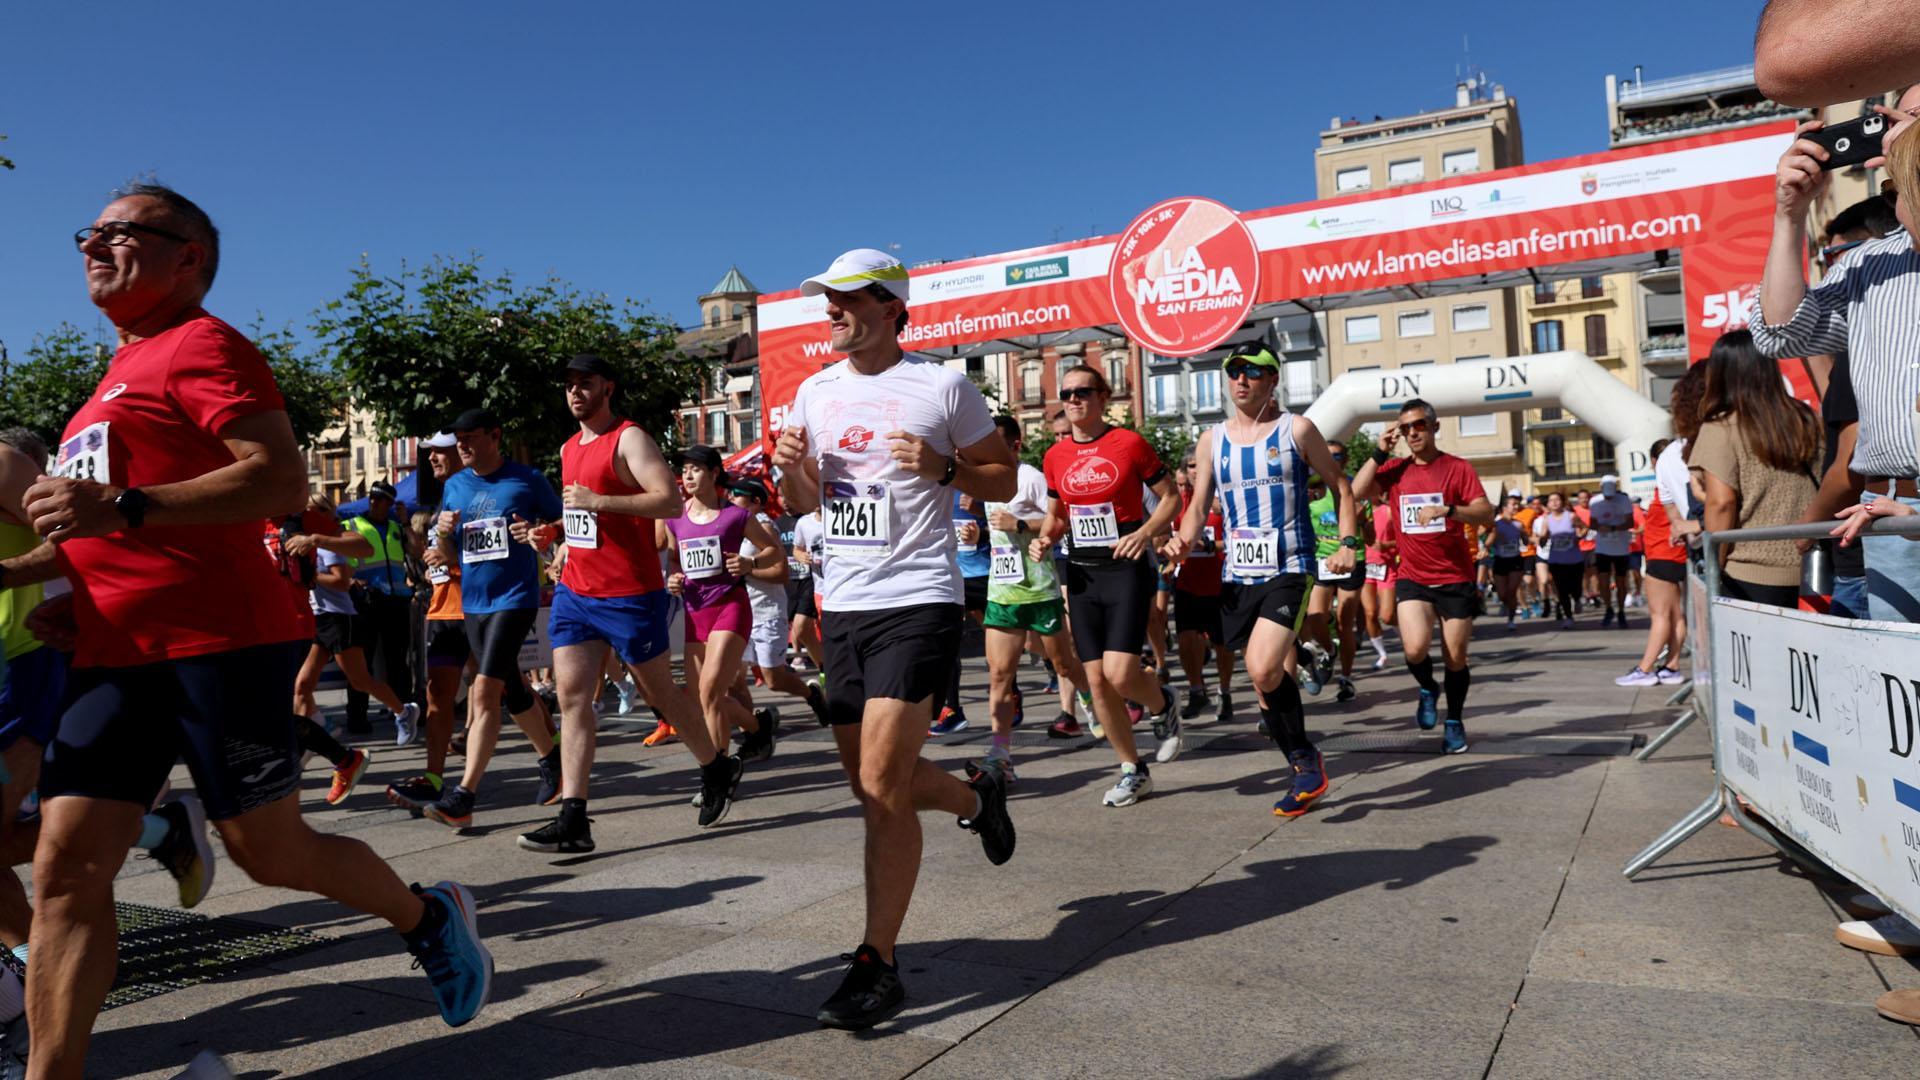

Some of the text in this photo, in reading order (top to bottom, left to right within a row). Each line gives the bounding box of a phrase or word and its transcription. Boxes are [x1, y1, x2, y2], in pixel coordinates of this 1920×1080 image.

[1431, 196, 1468, 214] IMQ
[1164, 245, 1206, 275] LA
[1302, 213, 1701, 285] www.lamediasanfermin.com
[945, 274, 985, 287] HYUNDAI
[1137, 267, 1243, 305] MEDIA
[1157, 292, 1244, 317] SAN FERMÍN
[1380, 374, 1421, 398] DN
[1485, 363, 1528, 389] DN
[1630, 451, 1647, 471] D
[832, 502, 876, 537] 21261
[1079, 517, 1108, 538] 21311
[468, 530, 501, 552] 21284
[1236, 542, 1269, 564] 21041
[687, 549, 714, 568] 21176
[1731, 631, 1751, 691] DN
[1788, 647, 1821, 723] DN
[1796, 763, 1835, 802] DIARIO DE
